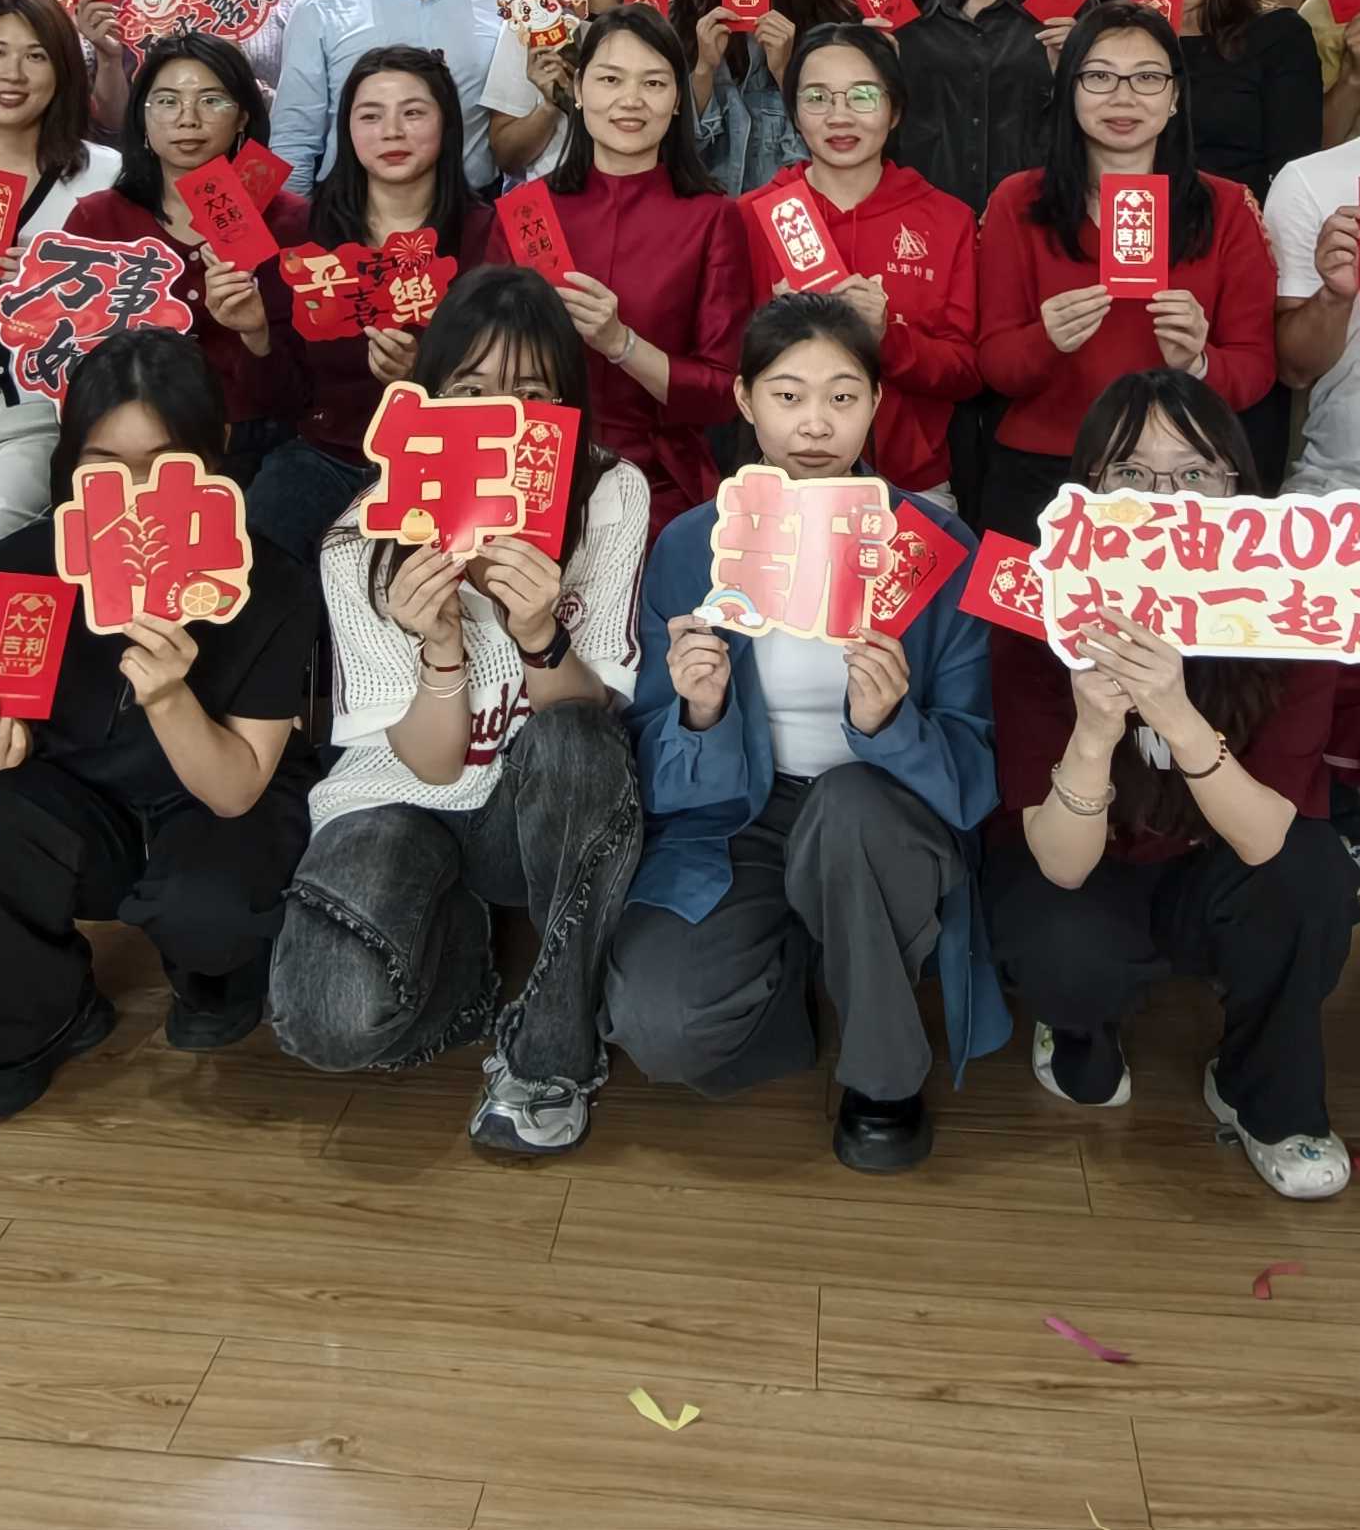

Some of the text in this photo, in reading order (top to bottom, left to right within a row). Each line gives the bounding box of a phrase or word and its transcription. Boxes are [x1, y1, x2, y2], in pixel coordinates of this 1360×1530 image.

[2, 241, 172, 331] 万事
[62, 460, 245, 626] 快
[366, 389, 518, 551] 年
[719, 471, 880, 638] 新
